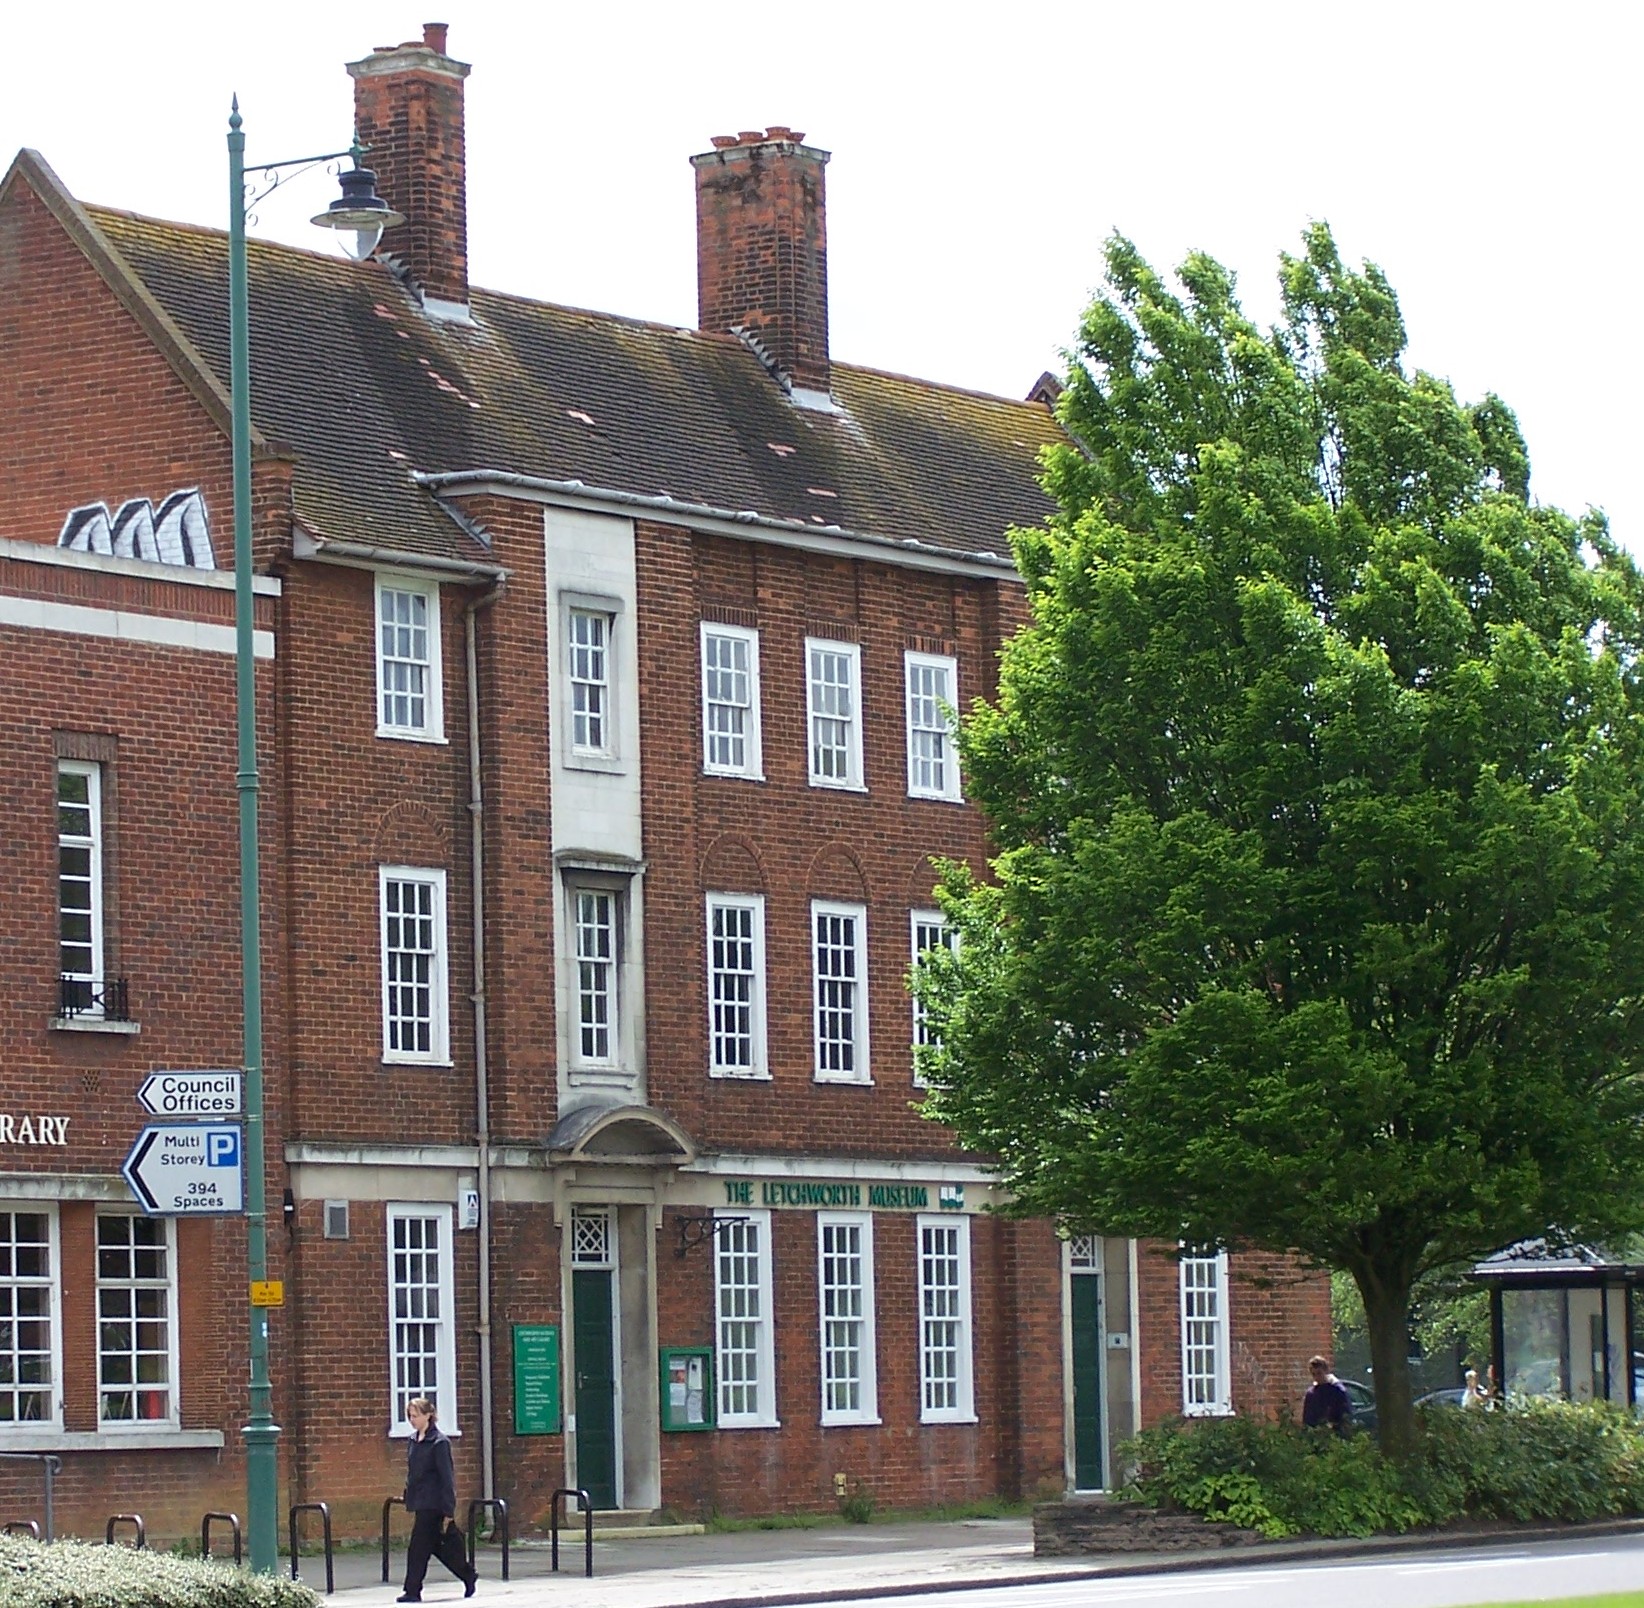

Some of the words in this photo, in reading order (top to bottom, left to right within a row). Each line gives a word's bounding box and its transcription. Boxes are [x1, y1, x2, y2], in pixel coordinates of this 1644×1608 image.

[162, 1077, 235, 1094] Council
[163, 1095, 235, 1111] Offices
[0, 1114, 71, 1146] RARY
[164, 1136, 200, 1147] Multi
[210, 1134, 235, 1165] P
[161, 1154, 206, 1166] Storey
[187, 1182, 217, 1194] 394
[723, 1180, 755, 1206] THE
[762, 1181, 862, 1208] LETCHWORTH
[868, 1184, 929, 1208] MUSEUM
[173, 1196, 224, 1209] Spaces
